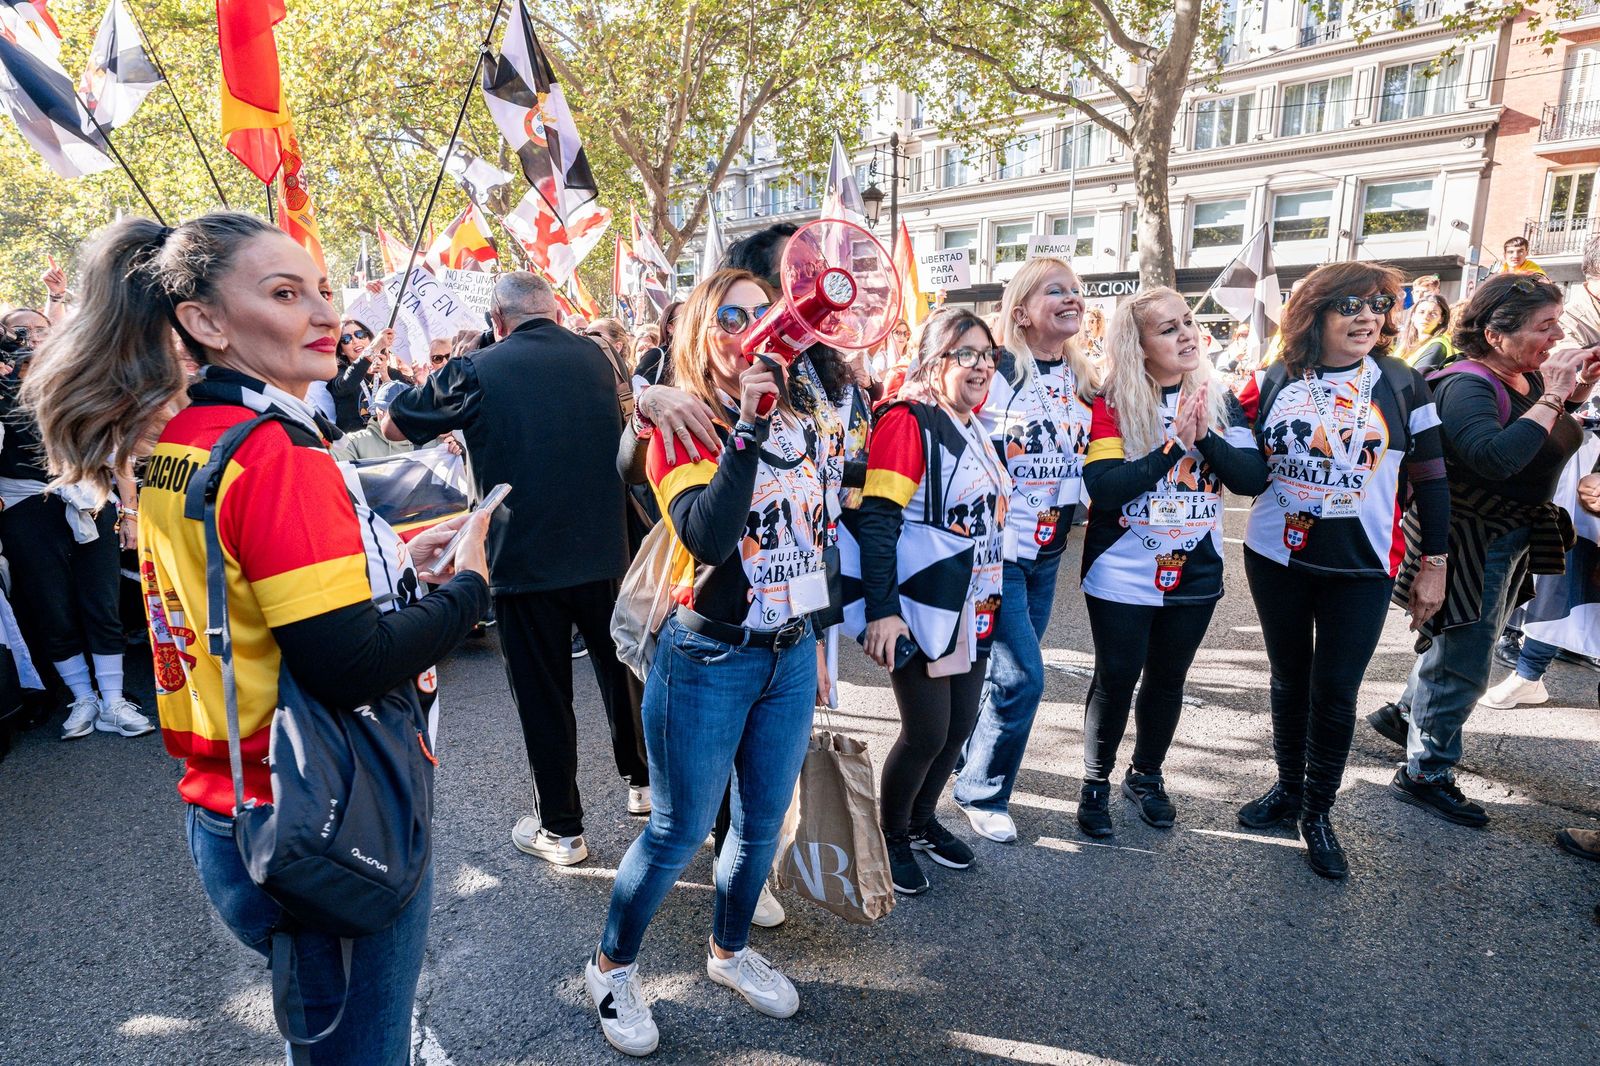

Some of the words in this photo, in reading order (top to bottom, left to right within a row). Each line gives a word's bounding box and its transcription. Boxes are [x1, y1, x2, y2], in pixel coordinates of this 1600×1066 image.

[1034, 244, 1071, 254] INFANCIA
[920, 252, 963, 265] LIBERTAD
[930, 264, 954, 274] PARA
[445, 269, 457, 282] NO
[460, 272, 473, 283] ES
[930, 274, 959, 285] CEUTA
[408, 267, 439, 297] NG
[431, 293, 459, 317] EN
[1080, 280, 1141, 297] NACION
[1308, 382, 1327, 416] CABALLAS
